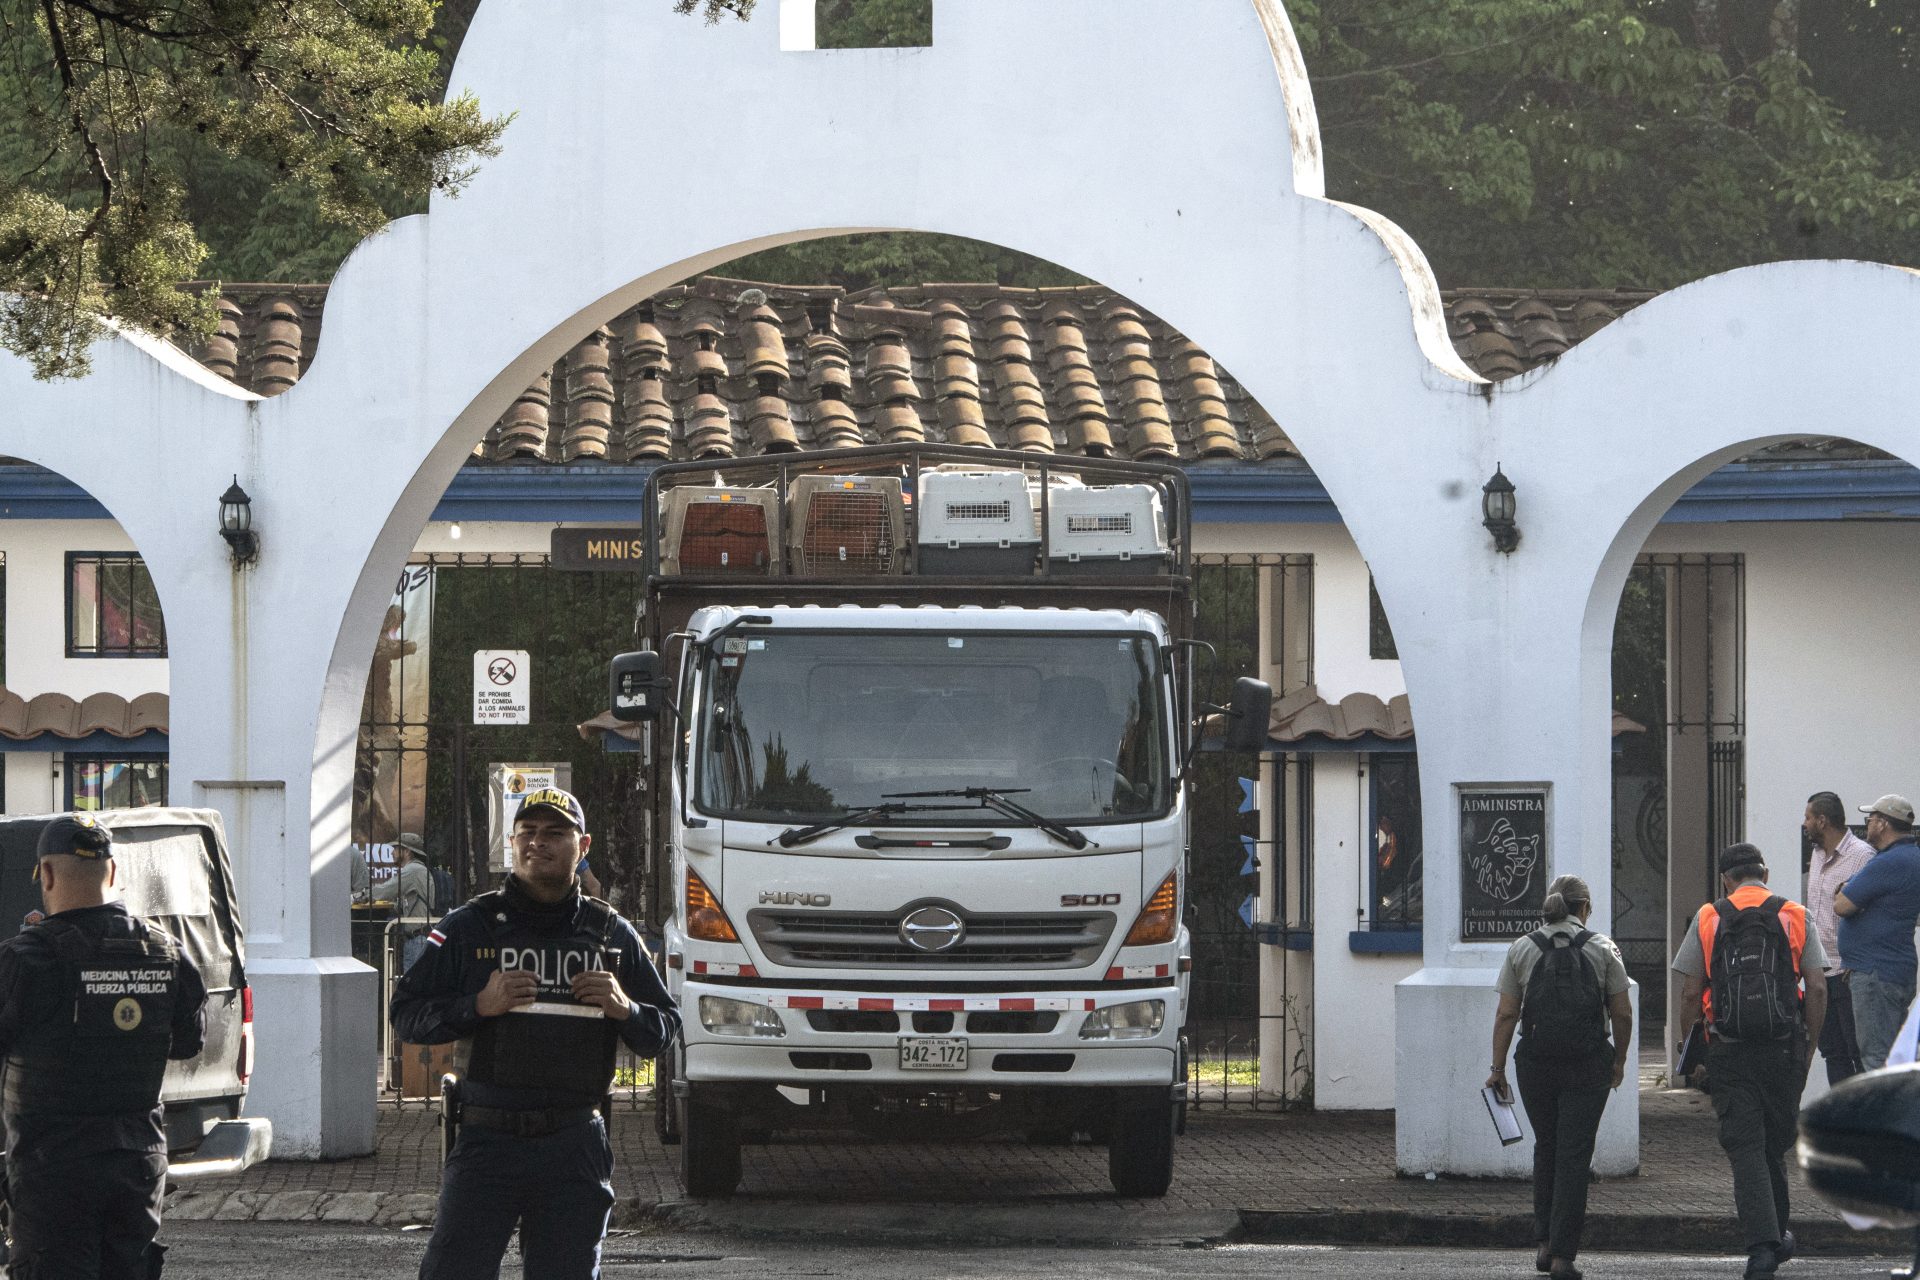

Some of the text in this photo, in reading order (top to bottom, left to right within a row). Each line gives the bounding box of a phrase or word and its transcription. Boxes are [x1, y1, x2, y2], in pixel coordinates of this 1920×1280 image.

[587, 539, 643, 560] MINIS
[1462, 799, 1543, 812] ADMINISTRA
[759, 891, 832, 907] HINO
[1060, 893, 1121, 907] 500
[501, 947, 605, 985] POLICIA
[81, 967, 172, 982] MEDICINA TÁCTICA
[86, 981, 167, 994] FUERZA PÚBLICA
[903, 1046, 964, 1062] 342-172
